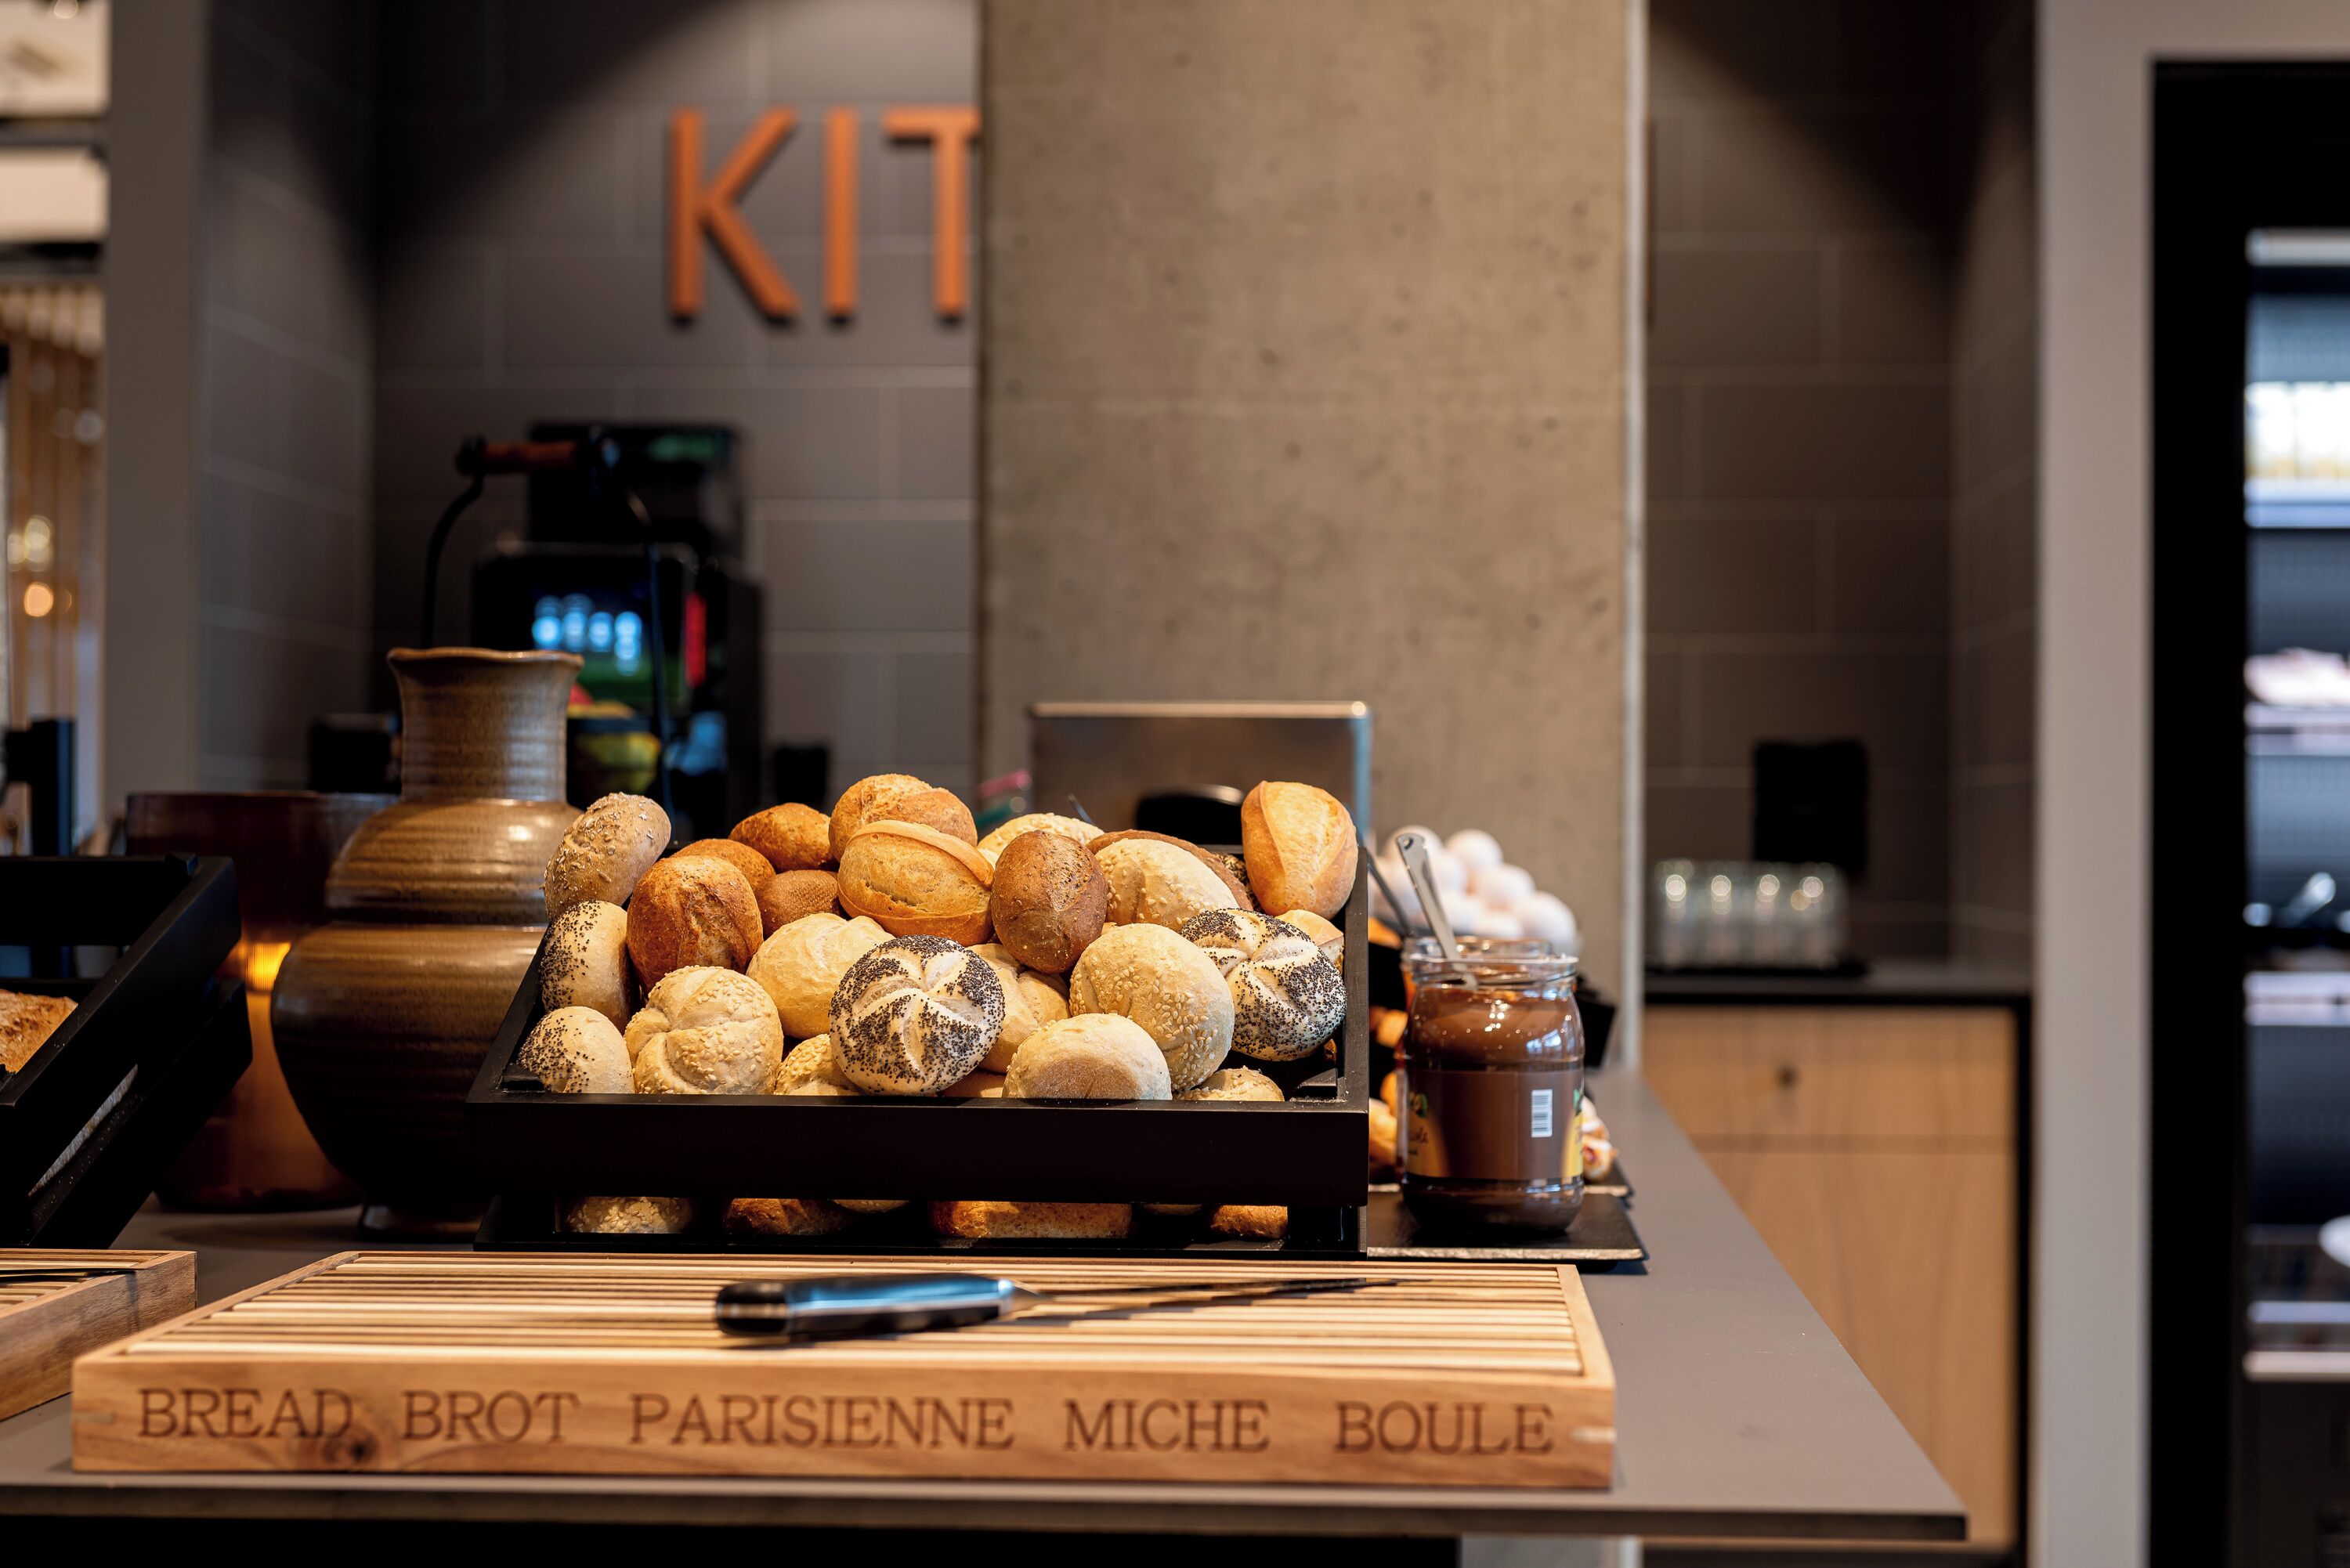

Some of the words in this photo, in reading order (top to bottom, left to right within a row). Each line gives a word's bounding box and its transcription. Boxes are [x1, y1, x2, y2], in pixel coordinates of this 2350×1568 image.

[668, 106, 981, 317] KIT
[138, 1388, 353, 1439] BREAD
[403, 1389, 578, 1443] BROT
[629, 1393, 1015, 1449] PARISIENNE
[1063, 1398, 1271, 1453] MICHE
[1334, 1401, 1555, 1456] BOULE
